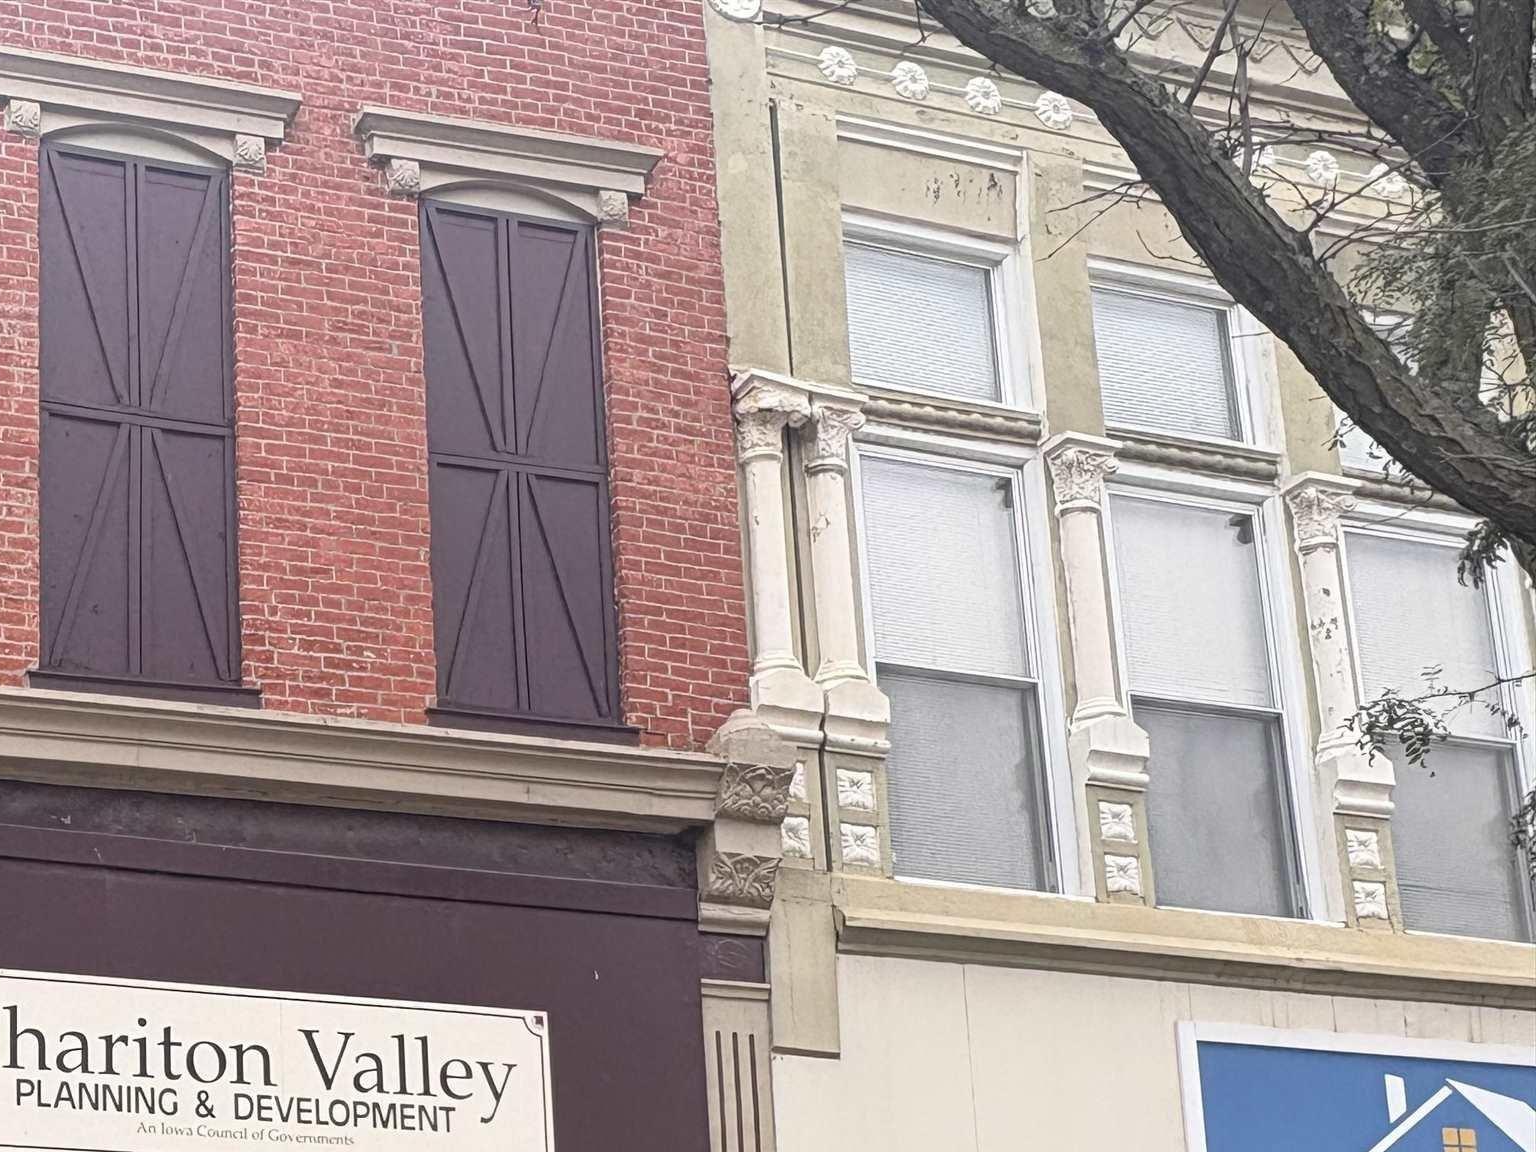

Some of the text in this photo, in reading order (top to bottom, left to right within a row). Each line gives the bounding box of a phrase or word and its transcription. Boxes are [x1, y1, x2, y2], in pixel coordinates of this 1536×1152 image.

[297, 1028, 518, 1124] Valley
[16, 1078, 456, 1133] PLANNING & DEVELOPMENT
[137, 1122, 355, 1146] An Iowa Council of Governments
